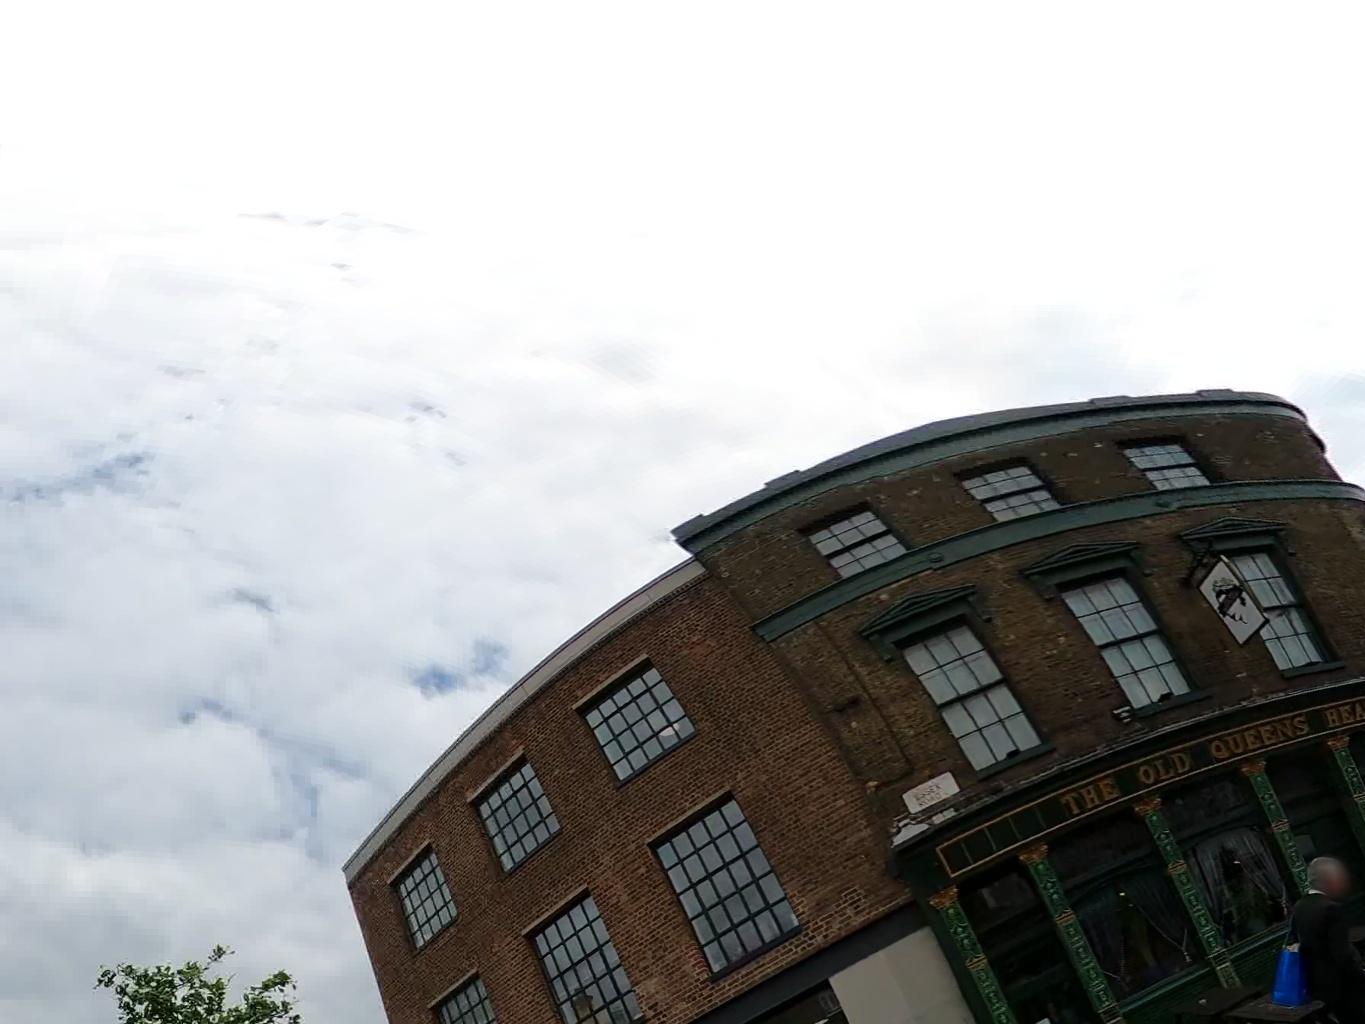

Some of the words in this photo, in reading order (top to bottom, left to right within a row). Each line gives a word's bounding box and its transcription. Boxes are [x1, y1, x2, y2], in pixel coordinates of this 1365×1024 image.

[1061, 776, 1121, 815] THE
[1138, 750, 1193, 786] OLD
[1209, 716, 1310, 760] QUEENS
